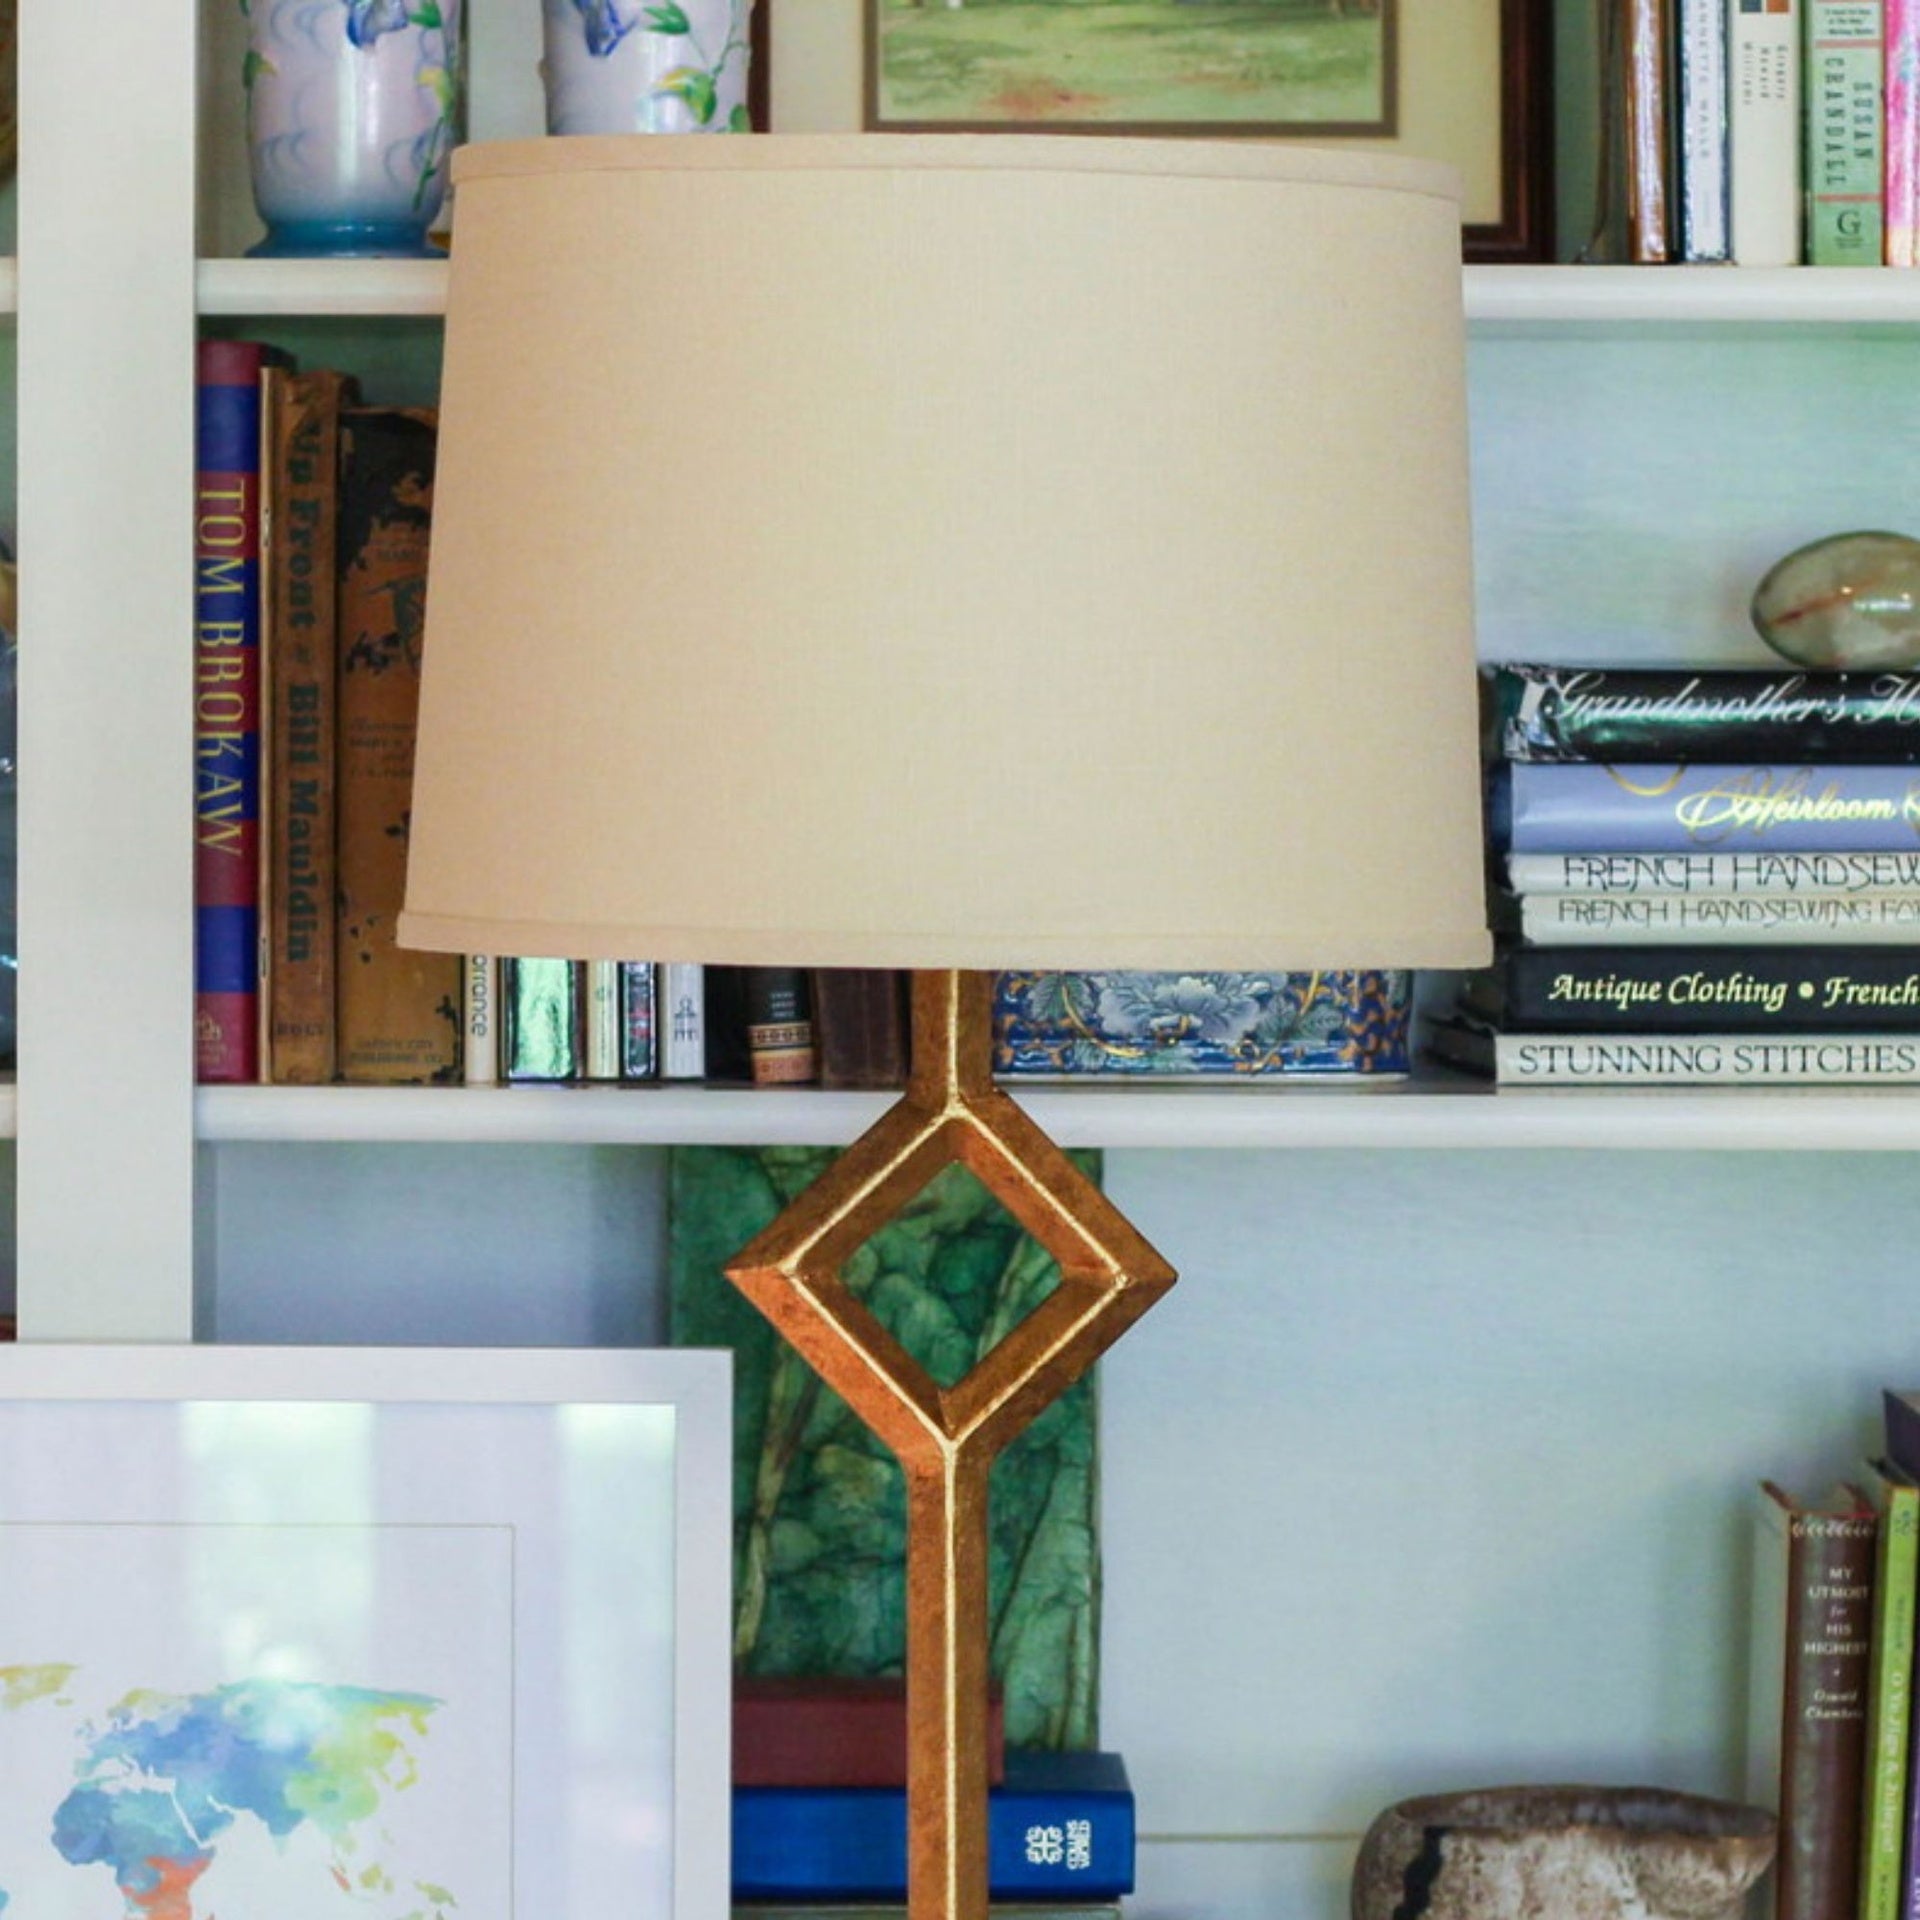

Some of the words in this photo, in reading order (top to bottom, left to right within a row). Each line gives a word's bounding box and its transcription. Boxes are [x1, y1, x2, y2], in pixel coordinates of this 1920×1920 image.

[1825, 57, 1846, 186] CRANDALL
[1853, 82, 1874, 159] SUSAN
[1837, 210, 1861, 236] G
[199, 481, 245, 595] TOM
[289, 499, 319, 628] Front
[288, 685, 319, 764] Bill
[1557, 671, 1848, 724] Grandmother's
[198, 621, 245, 856] BROKAW
[1676, 766, 1897, 844] Heirloom
[288, 780, 319, 962] Mauldin
[1563, 855, 1714, 893] FRENCH
[1558, 899, 1669, 929] FRENCH
[1680, 899, 1872, 929] HANDSEWING
[1549, 973, 1662, 1010] Antique
[1668, 972, 1788, 1012] Clothing
[1821, 975, 1919, 1009] French
[1518, 1043, 1722, 1076] STUNNING
[1733, 1043, 1917, 1076] STITCHES
[1829, 1567, 1853, 1580] MY
[1826, 1624, 1852, 1636] HIS
